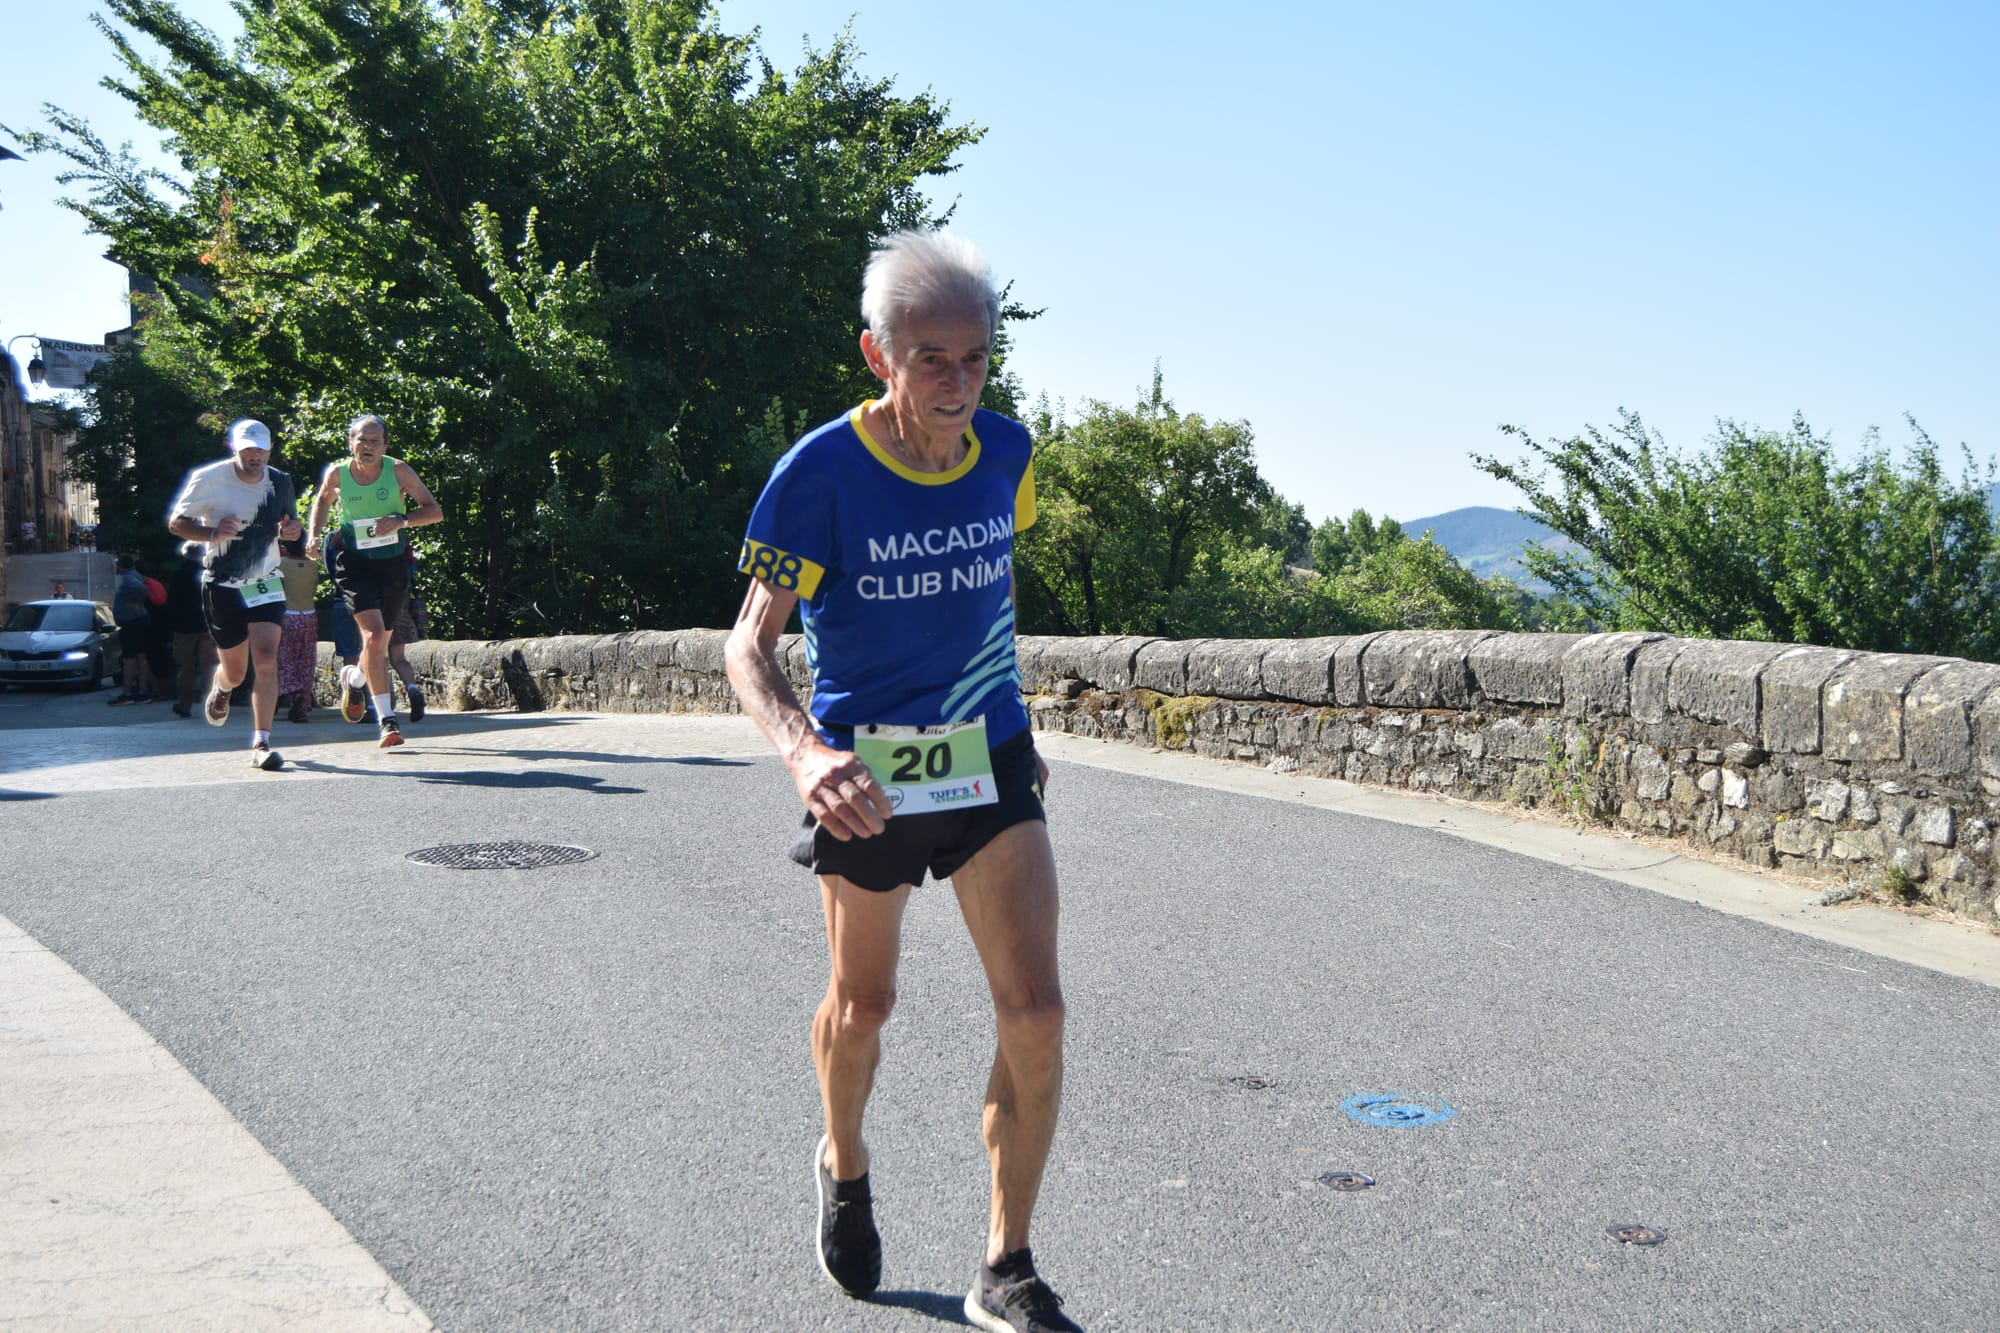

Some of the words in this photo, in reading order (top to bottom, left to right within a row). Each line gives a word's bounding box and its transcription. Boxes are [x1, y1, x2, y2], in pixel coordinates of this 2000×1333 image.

[42, 340, 92, 353] MAISON
[868, 513, 1014, 562] MACADAM
[857, 571, 942, 600] CLUB
[891, 741, 952, 782] 20
